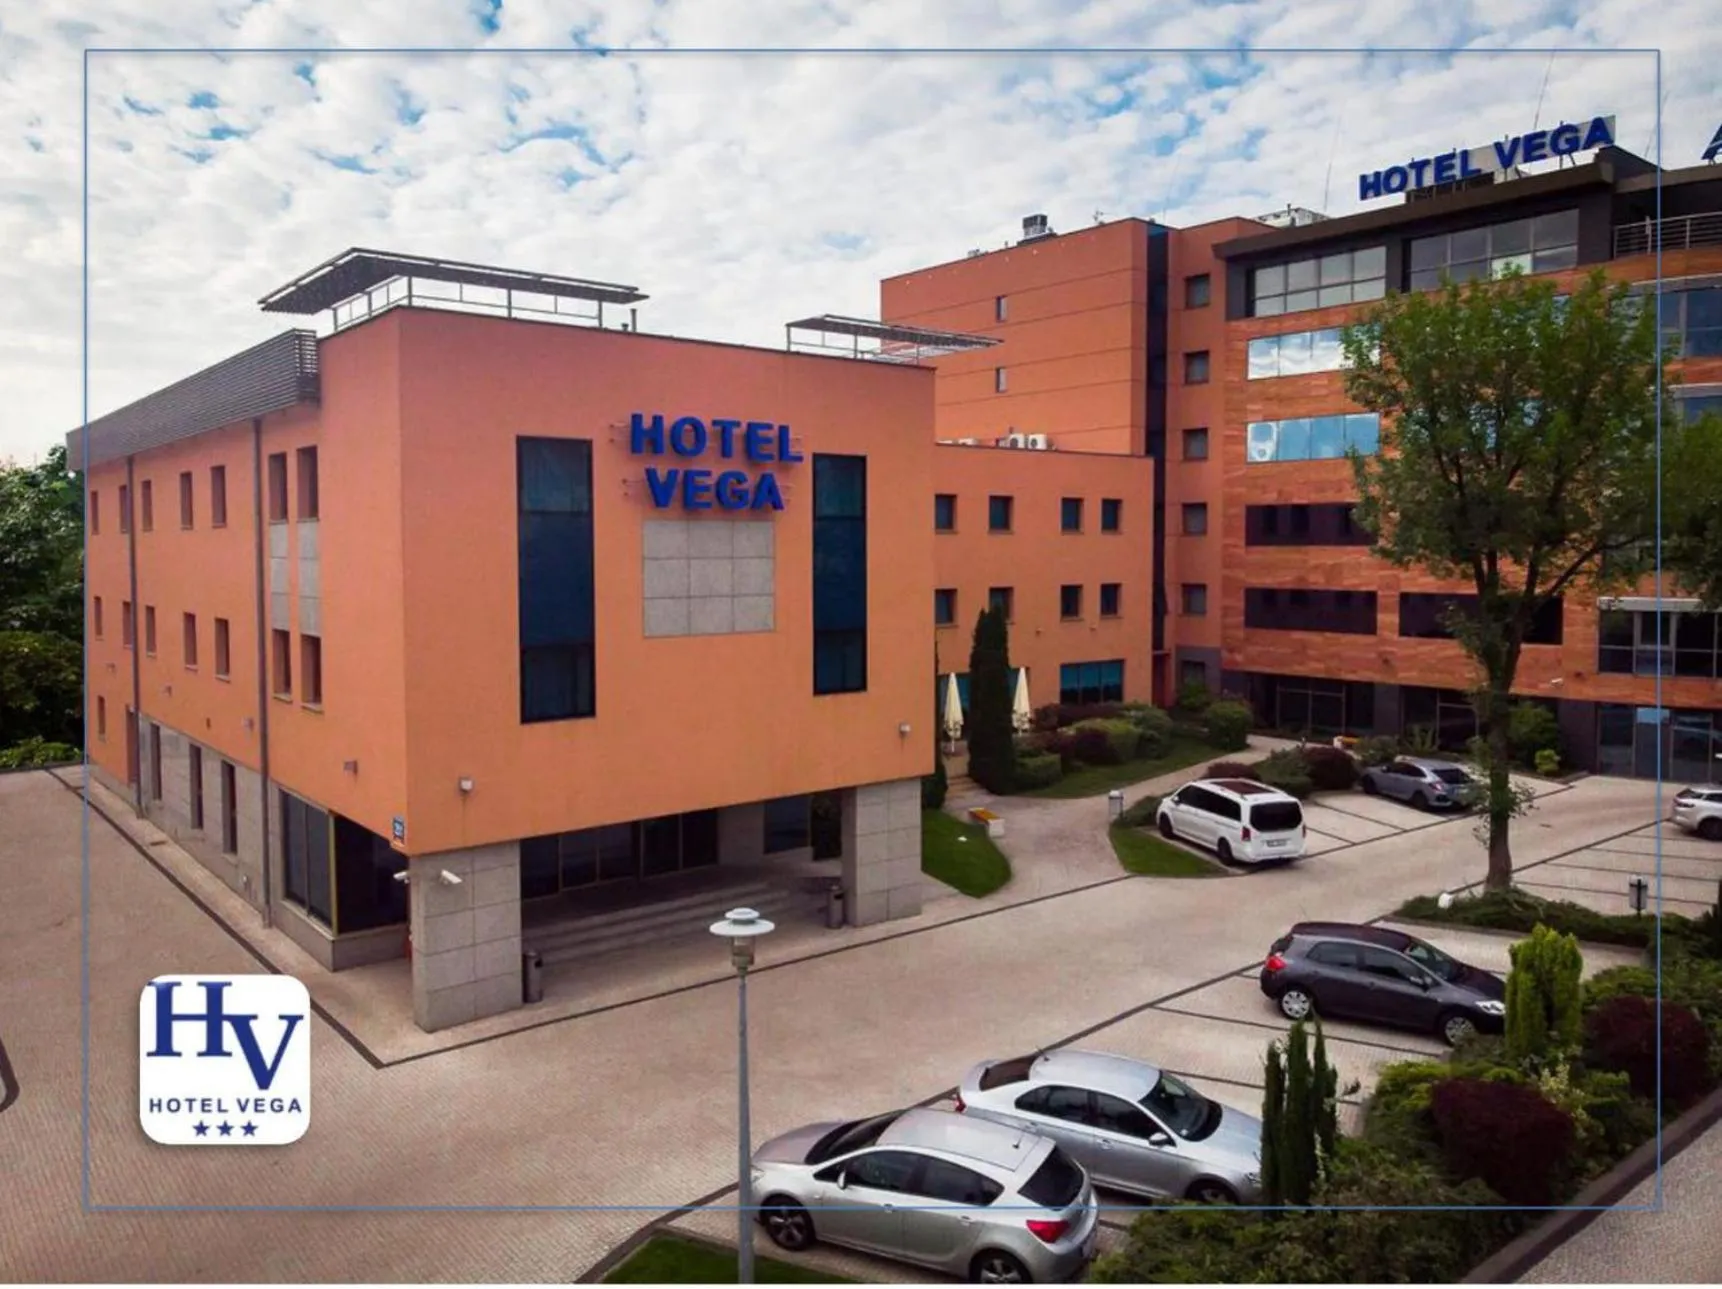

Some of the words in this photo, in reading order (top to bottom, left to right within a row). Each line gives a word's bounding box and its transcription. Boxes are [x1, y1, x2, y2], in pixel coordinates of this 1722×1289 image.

[1359, 149, 1483, 200] HOTEL
[1493, 116, 1614, 169] VEGA
[630, 413, 804, 462] HOTEL
[645, 467, 784, 511] VEGA
